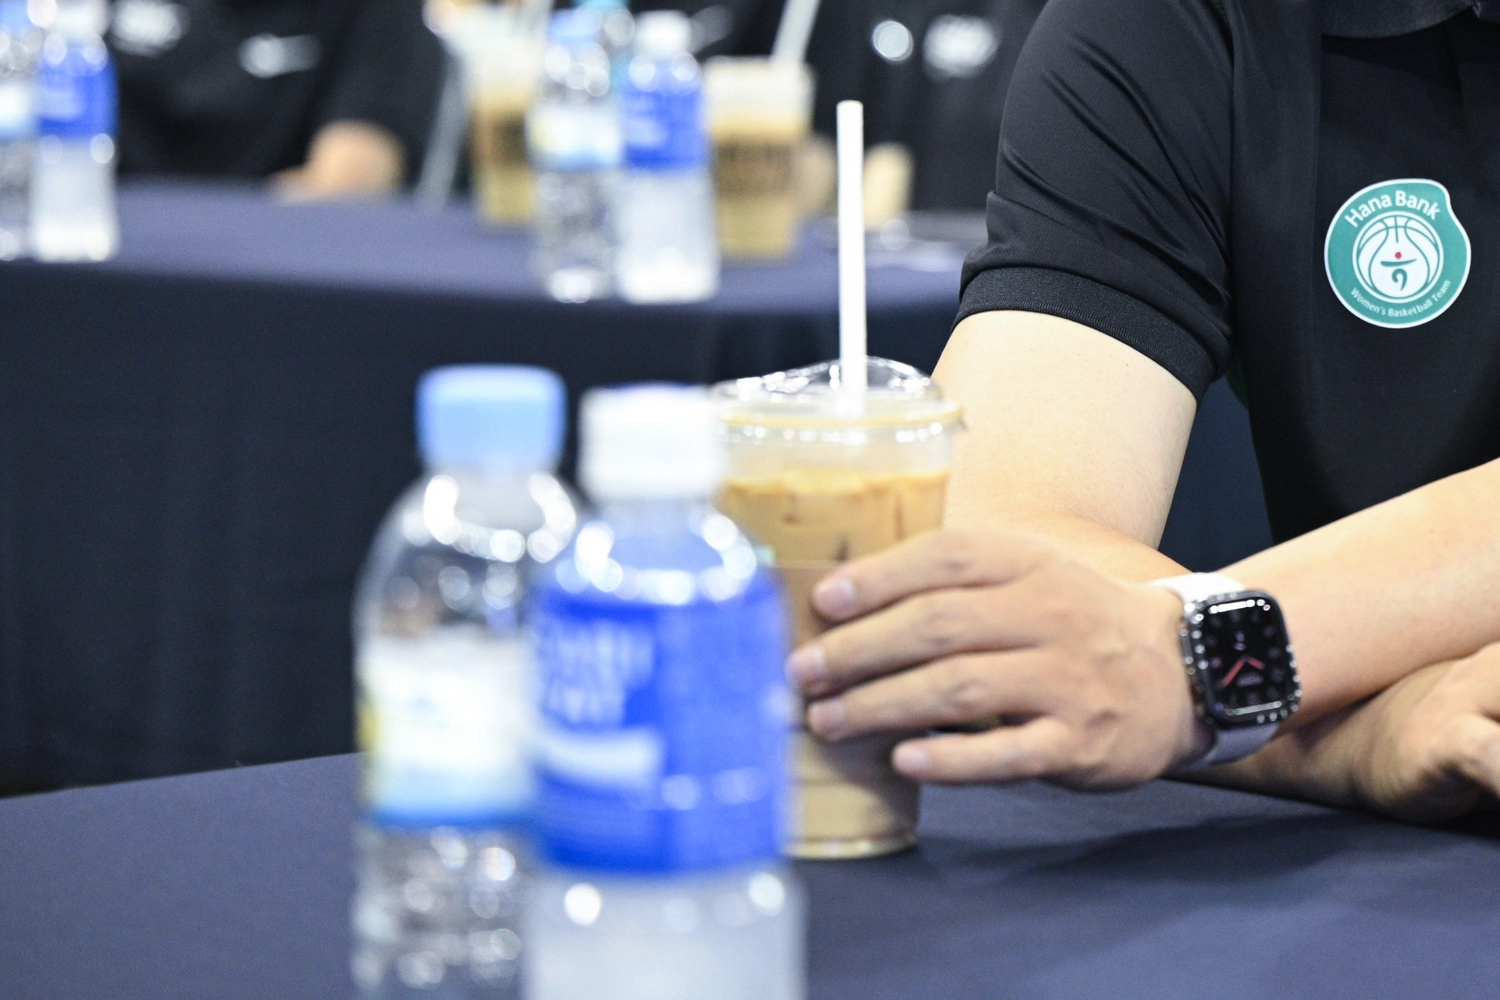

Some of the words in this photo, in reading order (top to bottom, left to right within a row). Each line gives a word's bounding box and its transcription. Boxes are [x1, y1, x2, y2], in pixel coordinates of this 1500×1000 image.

[1344, 194, 1392, 228] Hana
[1395, 190, 1440, 220] Bank
[1350, 287, 1386, 316] Women's
[1387, 299, 1433, 317] Basketball
[1432, 280, 1451, 302] Team
